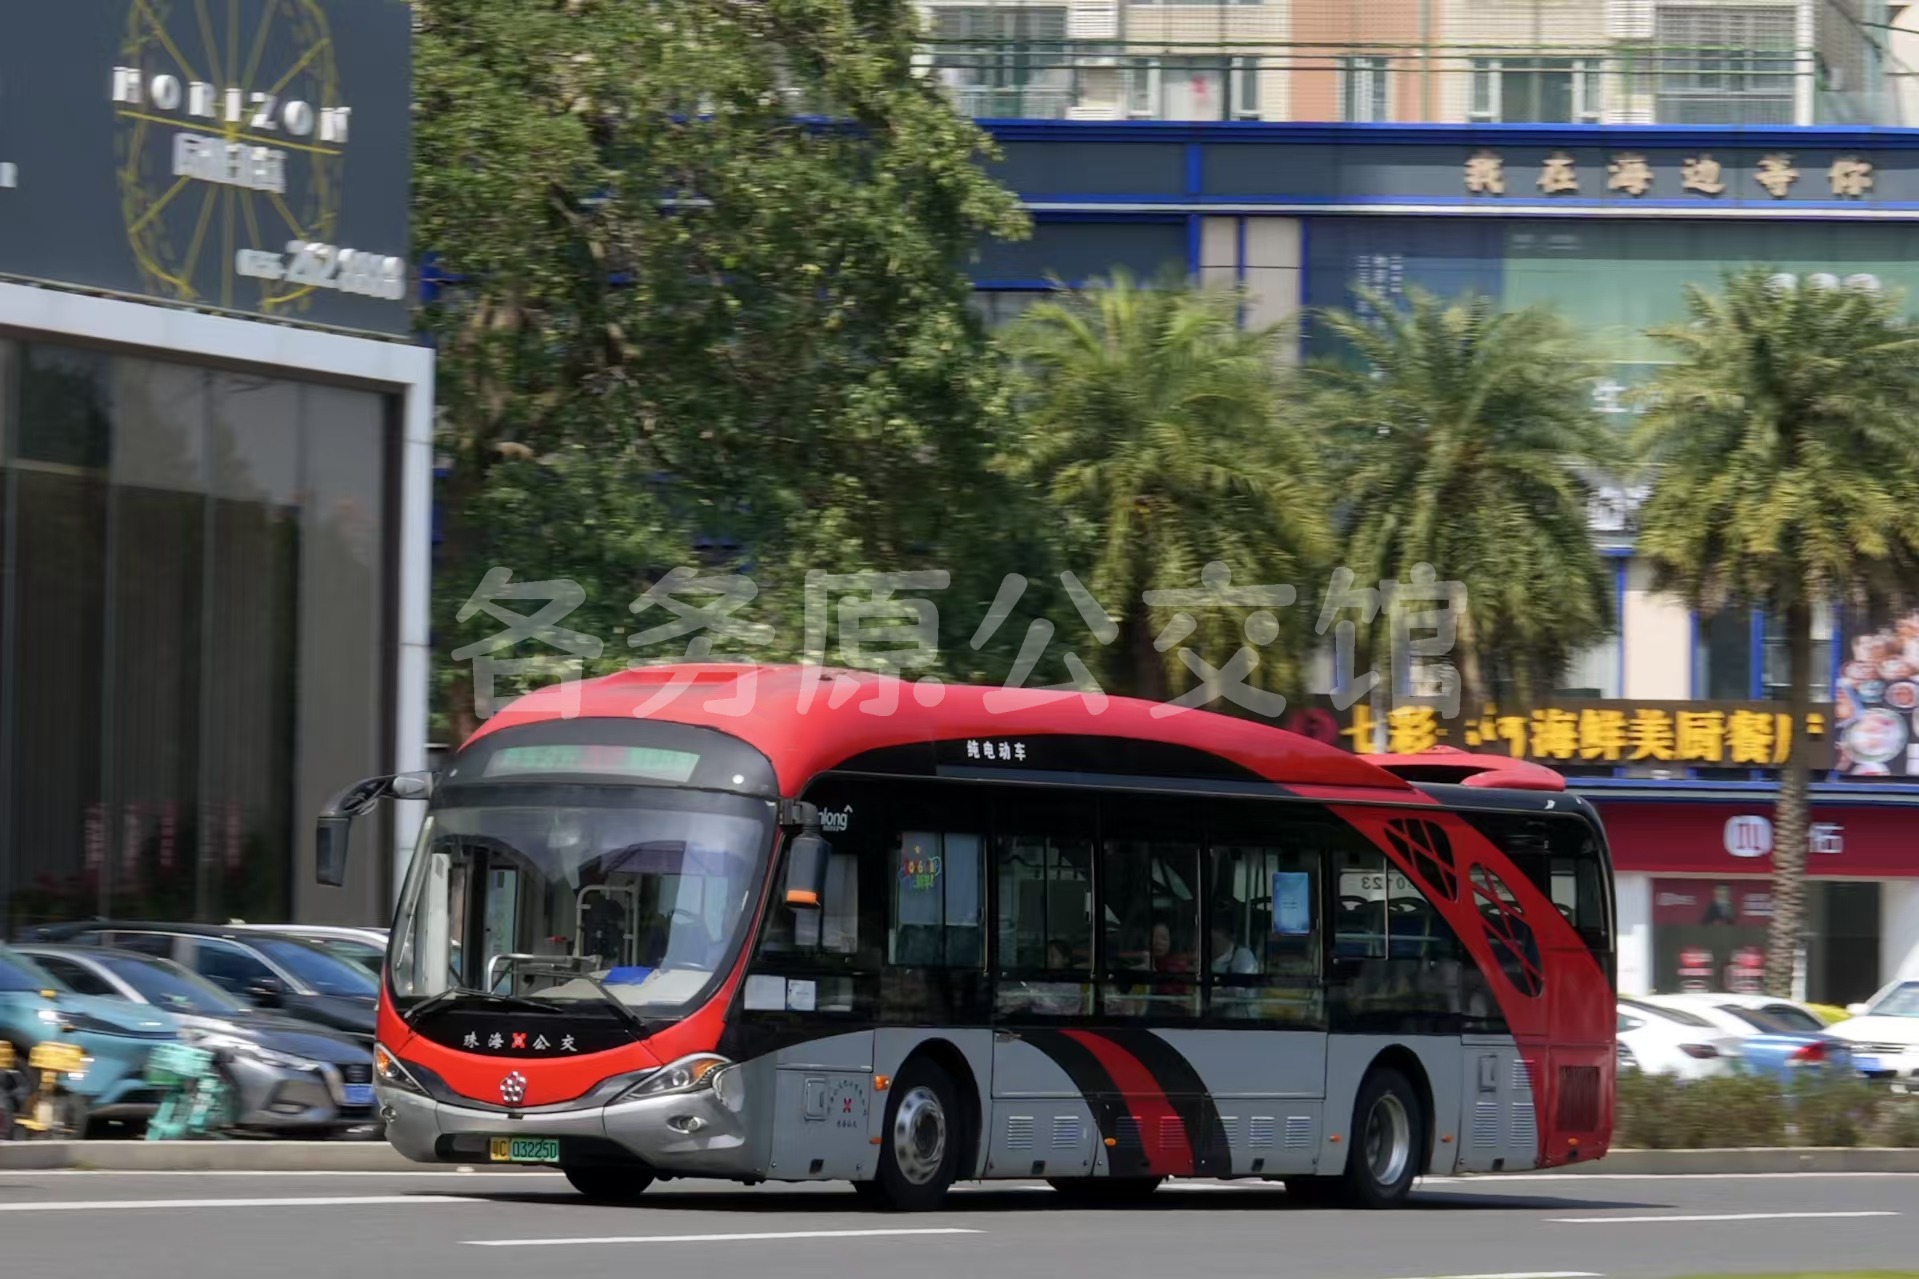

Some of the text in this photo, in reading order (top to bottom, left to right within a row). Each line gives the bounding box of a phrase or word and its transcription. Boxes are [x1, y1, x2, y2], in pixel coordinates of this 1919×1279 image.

[113, 66, 352, 143] HORIZON
[967, 739, 1026, 761] 纯电动车
